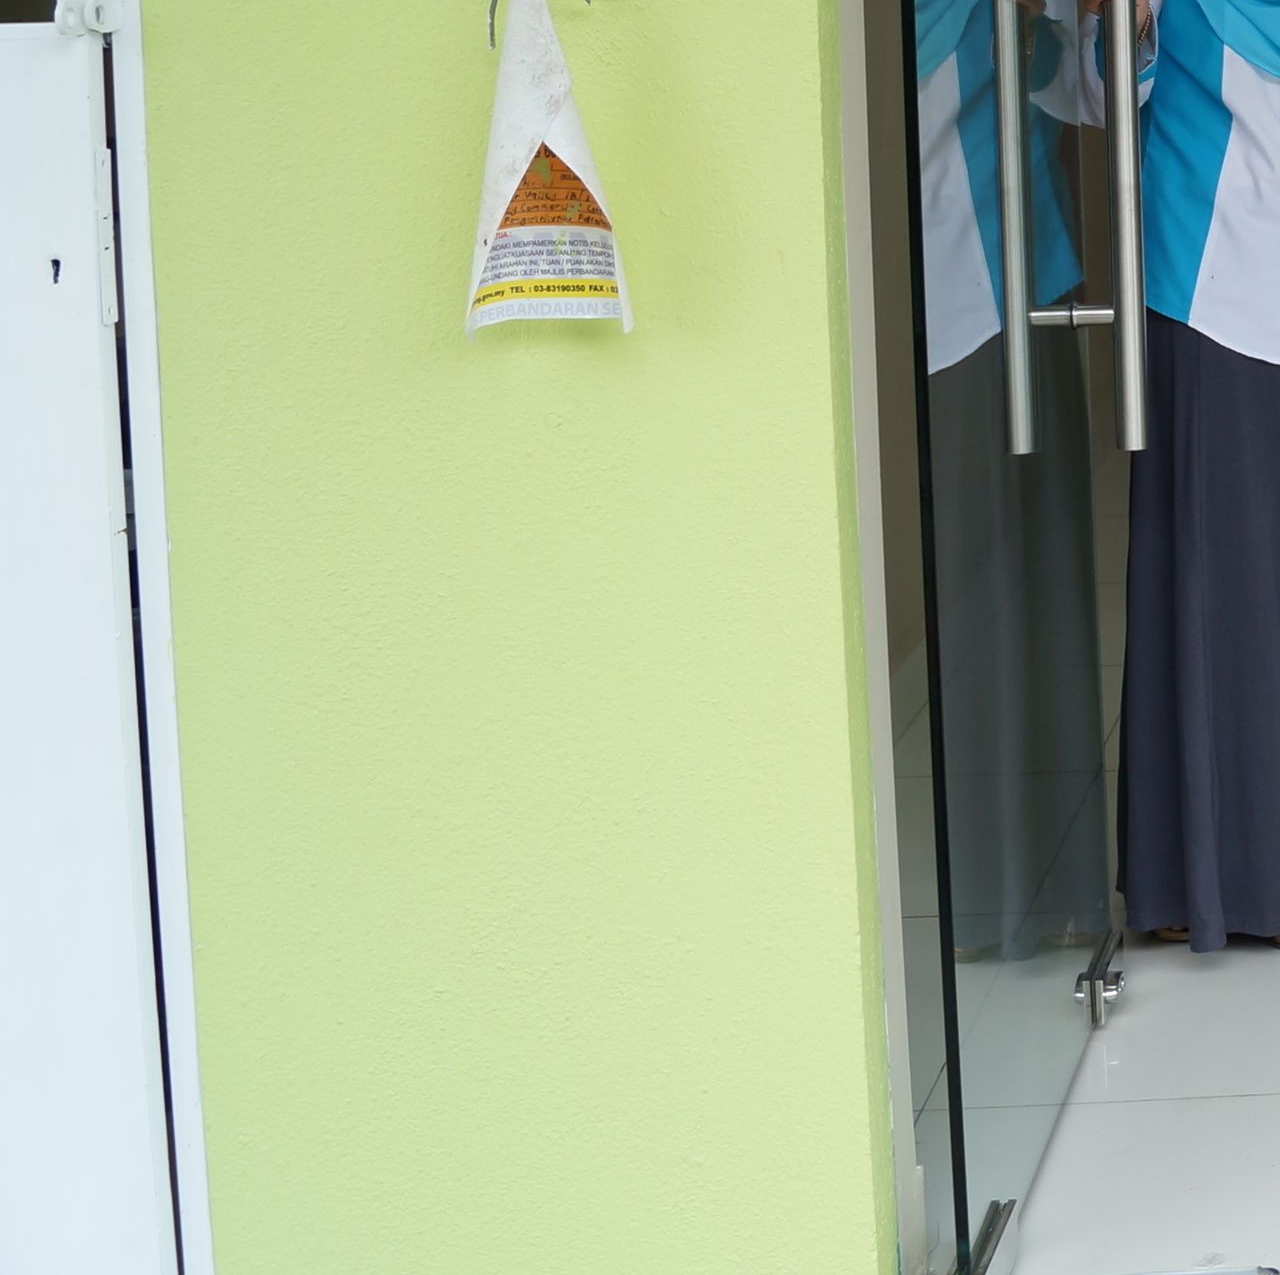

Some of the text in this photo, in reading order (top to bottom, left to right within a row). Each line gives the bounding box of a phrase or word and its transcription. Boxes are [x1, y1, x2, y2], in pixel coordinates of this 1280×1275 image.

[542, 258, 561, 267] TUAN
[566, 258, 585, 267] PUAN
[520, 269, 539, 277] OLEH
[541, 267, 566, 276] MAJLIS
[510, 285, 526, 294] TEL
[534, 284, 586, 293] 03-83190350
[589, 285, 605, 293] FAX
[480, 301, 600, 324] PERBANDARAN
